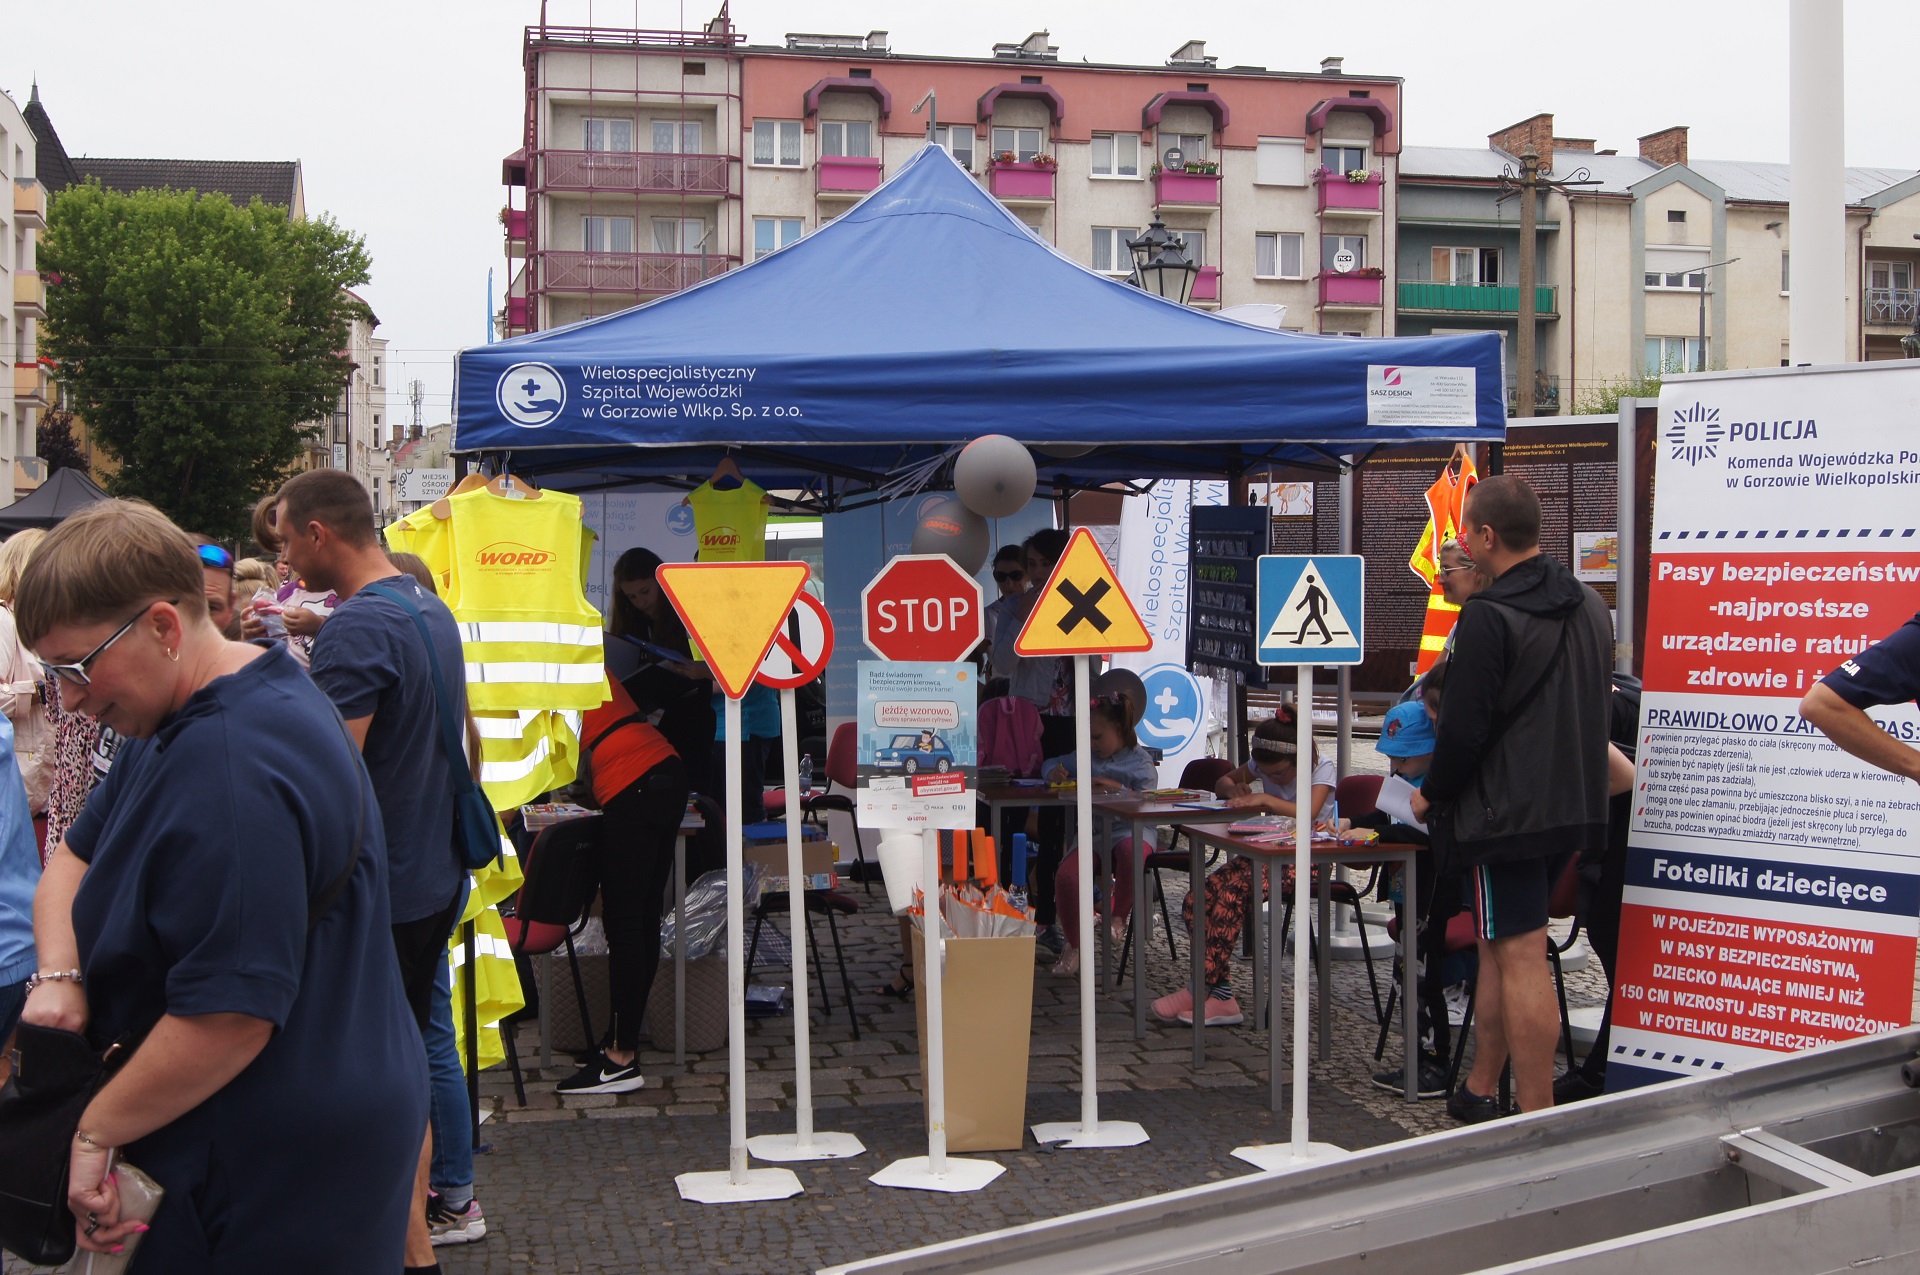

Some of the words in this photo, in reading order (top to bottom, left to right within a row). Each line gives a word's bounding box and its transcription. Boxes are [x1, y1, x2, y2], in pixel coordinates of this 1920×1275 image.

[581, 366, 756, 382] Wielospecjalistyczny
[582, 385, 641, 401] Szpital
[646, 384, 742, 399] Wojewódzki
[582, 408, 594, 418] w
[600, 404, 678, 419] Gorzowie
[682, 403, 727, 421] Wlkp.
[731, 404, 756, 419] Sp.
[762, 406, 770, 417] z
[774, 406, 803, 418] o.o.
[1730, 420, 1818, 442] POLICJA
[1728, 455, 1793, 469] Komenda
[1799, 452, 1893, 469] Wojewódzka
[1727, 478, 1738, 488] w
[1744, 474, 1810, 488] Gorzowie
[481, 553, 549, 565] WORD
[1658, 562, 1714, 585] Pasy
[877, 597, 969, 633] STOP
[1709, 598, 1869, 621] -najprostsze
[1662, 632, 1796, 655] urządzenie
[1687, 667, 1788, 688] zdrowie
[1796, 670, 1803, 689] i
[882, 706, 908, 716] Jeżdżę
[910, 708, 951, 716] wzorowo,
[1648, 709, 1778, 732] PRAWIDŁOWO
[1651, 734, 1682, 743] powinien
[1684, 735, 1720, 746] przylegać
[1722, 736, 1746, 747] płasko
[1748, 738, 1757, 746] do
[1760, 738, 1776, 747] ciała
[1779, 739, 1816, 753] (skręcony
[1651, 746, 1679, 756] napięcia
[1681, 747, 1711, 756] podczas
[1713, 748, 1753, 761] zderzenia),
[1649, 758, 1680, 767] powinien
[1682, 760, 1695, 768] być
[1698, 761, 1724, 772] napięty
[1727, 763, 1744, 773] (jeśli
[1746, 764, 1757, 772] tak
[1759, 764, 1770, 773] nie
[1771, 765, 1786, 776] jest
[1825, 769, 1850, 779] uderza
[1861, 771, 1906, 785] kierownicę
[1649, 770, 1658, 778] lub
[1661, 772, 1681, 782] szybę
[1683, 773, 1705, 782] zanim
[1707, 776, 1720, 784] pas
[1722, 775, 1756, 786] zadziała),
[1647, 782, 1666, 792] górna
[1668, 784, 1690, 794] część
[1691, 786, 1708, 796] pasa
[1711, 788, 1742, 798] powinna
[1744, 790, 1757, 798] być
[1759, 790, 1808, 803] umieszczona
[1810, 794, 1834, 805] blisko
[1836, 797, 1852, 808] szyi,
[1861, 798, 1874, 807] nie
[1876, 800, 1886, 808] na
[1646, 794, 1668, 806] (mogą
[1670, 798, 1683, 806] one
[1685, 798, 1700, 807] ulec
[1702, 800, 1737, 812] złamaniu,
[1739, 803, 1778, 815] przebijając
[1780, 804, 1831, 818] jednocześnie
[1833, 810, 1854, 820] płuca
[1860, 812, 1888, 823] serce),
[1644, 819, 1673, 831] brzucha,
[1675, 822, 1706, 832] podczas
[1708, 825, 1741, 836] wypadku
[1743, 828, 1776, 841] zmiażdży
[1779, 832, 1809, 844] narządy
[1811, 835, 1861, 849] wewnętrzne).
[1645, 807, 1663, 819] dolny
[1666, 810, 1679, 819] pas
[1681, 811, 1714, 821] powinien
[1716, 814, 1741, 824] opinać
[1743, 814, 1766, 825] biodra
[1768, 817, 1790, 828] (jeżeli
[1791, 819, 1806, 830] jest
[1808, 821, 1843, 834] skręcony
[1845, 824, 1858, 833] lub
[1859, 826, 1894, 838] przylega
[1896, 828, 1907, 837] do
[1652, 858, 1748, 889] Foteliki
[1756, 869, 1888, 905] dziecięce
[1652, 913, 1666, 928] W
[1669, 916, 1750, 939] POJEŹDZIE
[1753, 925, 1874, 954] WYPOSAŻONYM
[1660, 940, 1674, 954] W
[1677, 941, 1715, 960] PASY
[1718, 947, 1860, 982] BEZPIECZEŃSTWA,
[1653, 964, 1717, 985] DZIECKO
[1720, 972, 1782, 996] MAJĄCE
[1786, 982, 1834, 1002] MNIEJ
[1620, 984, 1644, 1000] 150
[1647, 987, 1669, 1004] CM
[1674, 991, 1744, 1015] WZROSTU
[1748, 1003, 1787, 1021] JEST
[1640, 1011, 1653, 1026] W
[1655, 1014, 1728, 1038] FOTELIKU
